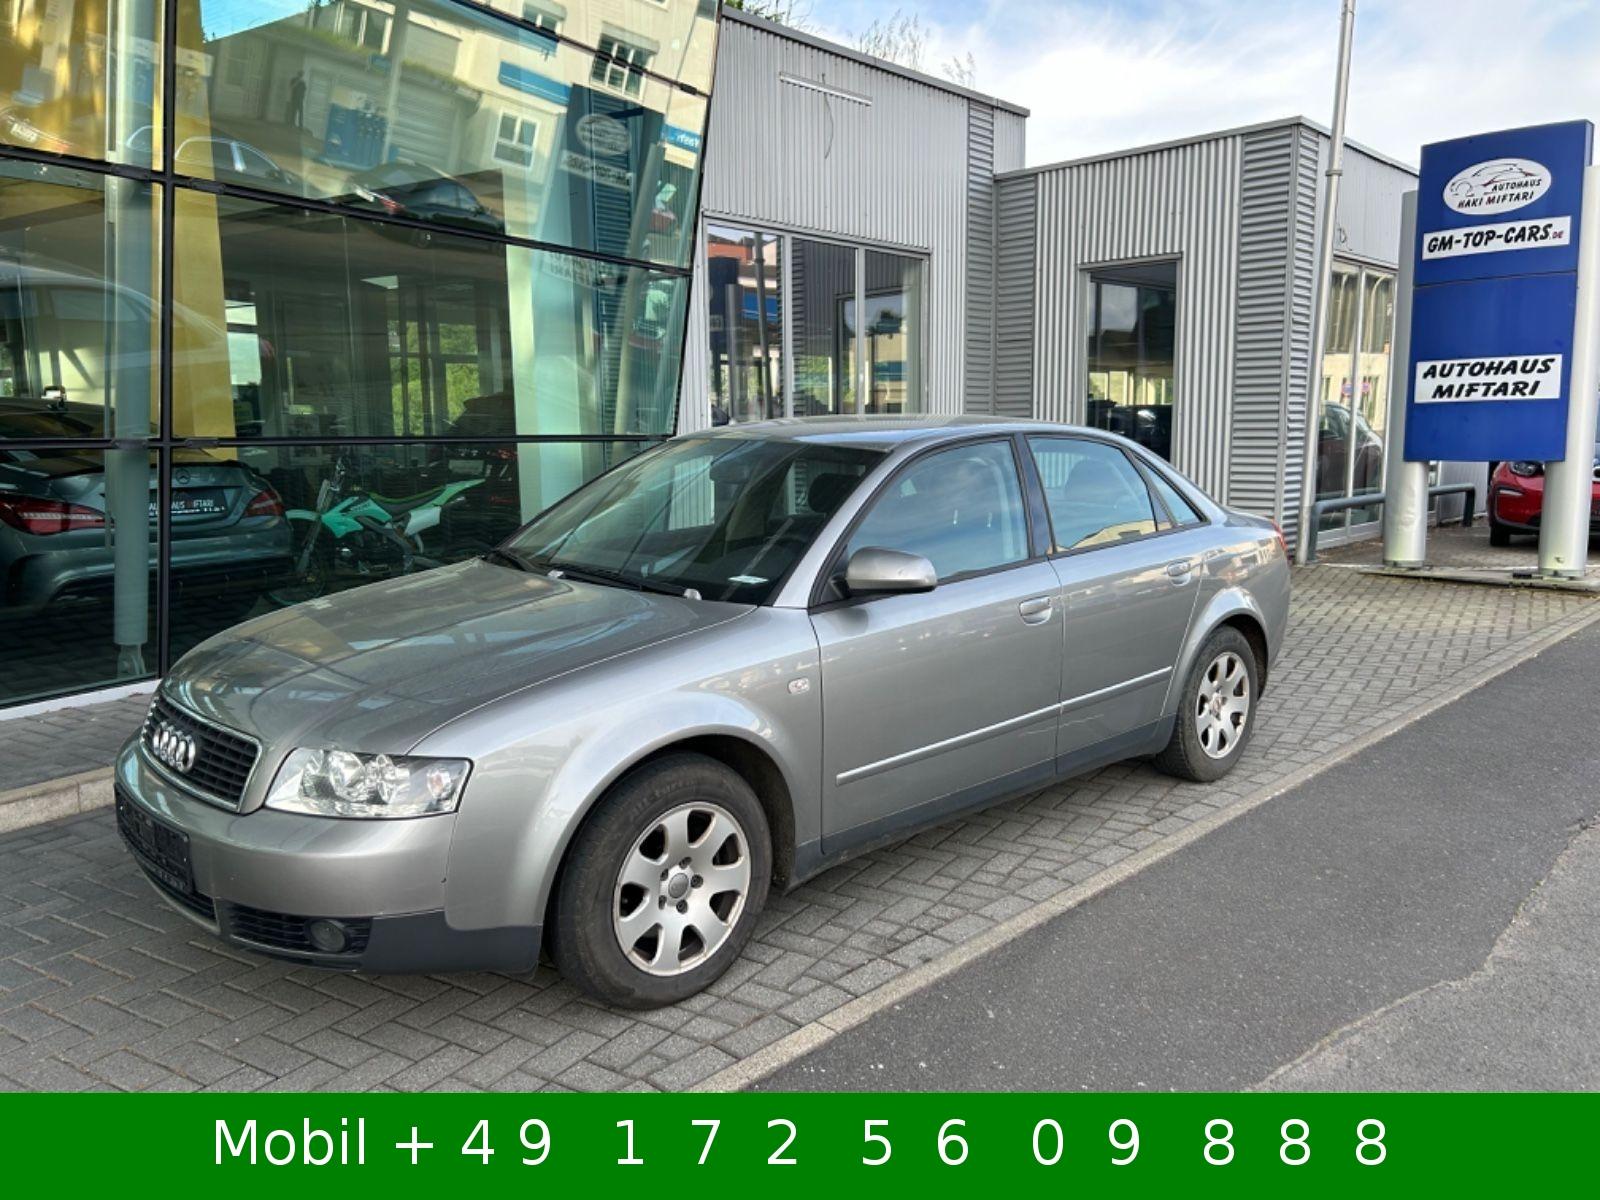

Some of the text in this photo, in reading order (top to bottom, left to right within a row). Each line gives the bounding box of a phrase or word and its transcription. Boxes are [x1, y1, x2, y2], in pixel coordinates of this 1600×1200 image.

[1491, 179, 1542, 192] AUTOHAUS
[1457, 191, 1534, 209] HAKI MIFTARI
[1422, 358, 1555, 379] AUTOHAUS
[1431, 380, 1541, 399] MIFTARI
